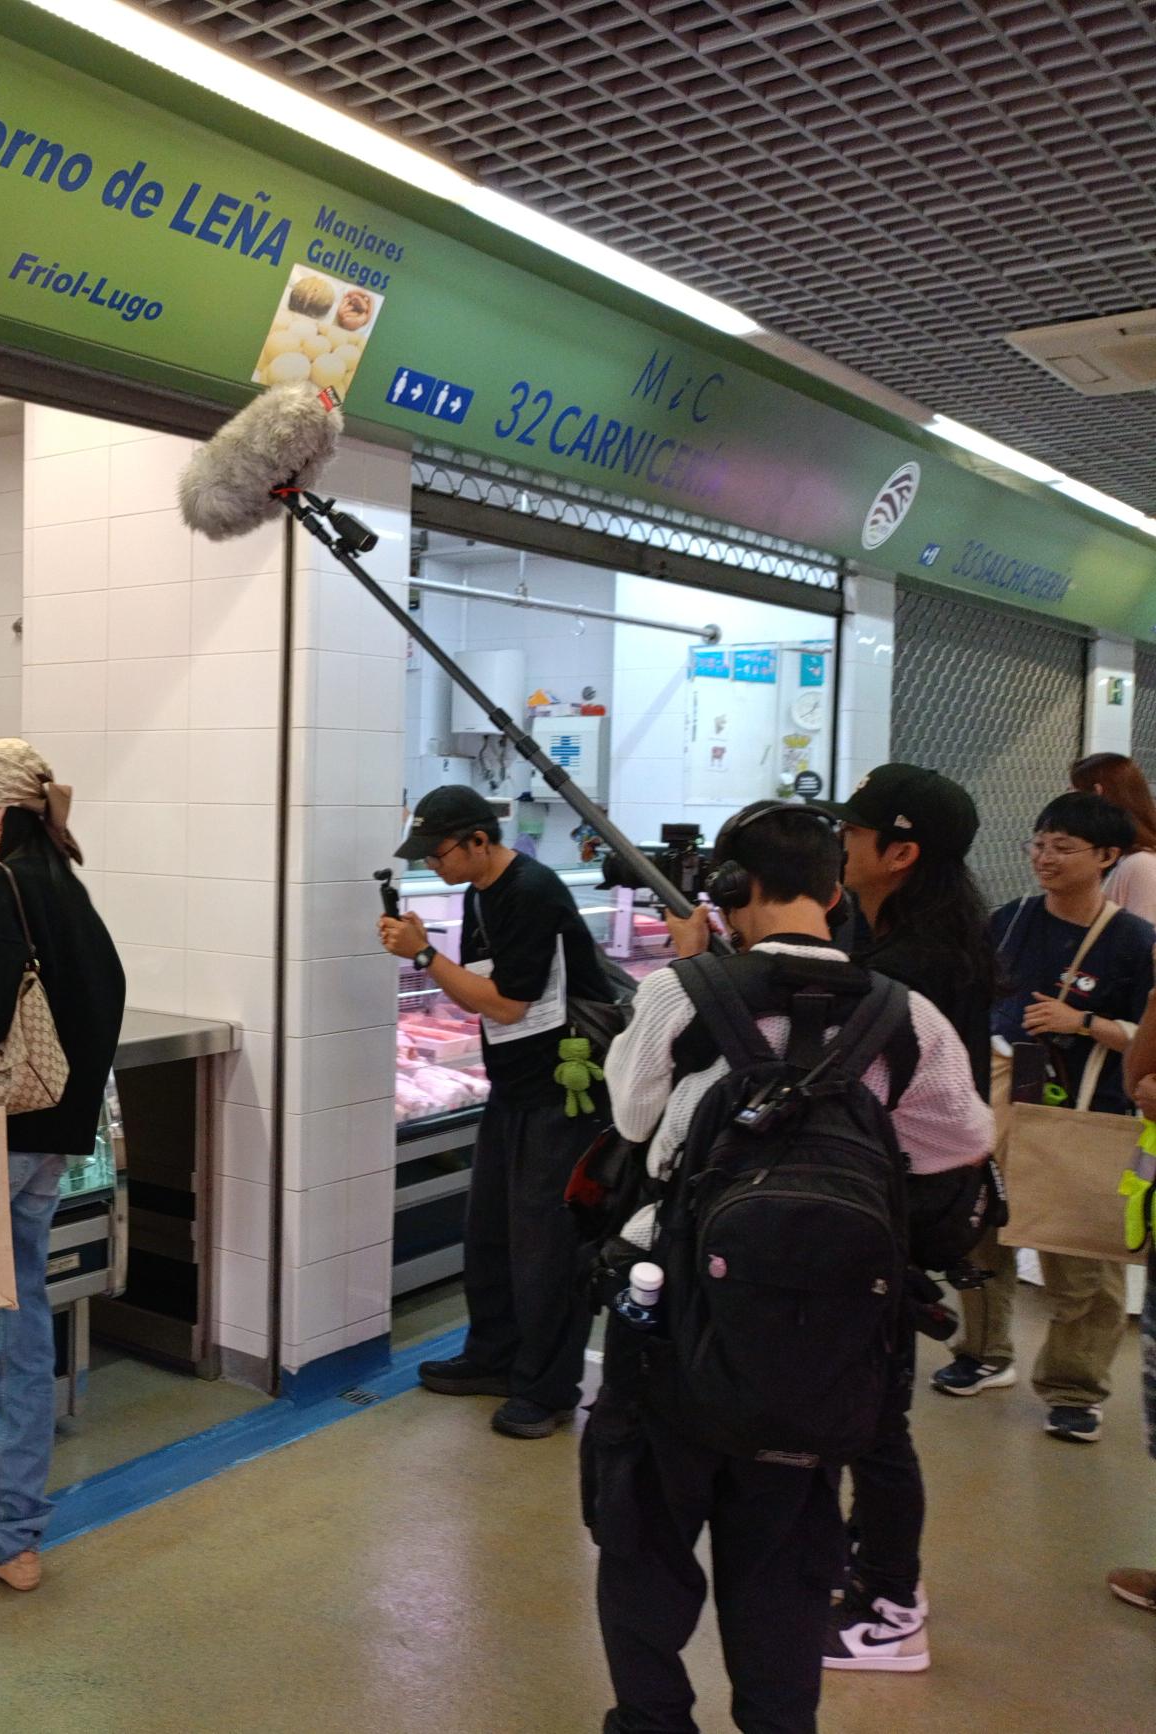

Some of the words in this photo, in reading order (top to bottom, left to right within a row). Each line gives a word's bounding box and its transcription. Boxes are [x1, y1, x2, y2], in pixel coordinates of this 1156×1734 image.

[101, 160, 164, 218] de
[169, 182, 292, 266] LEÑA
[314, 204, 405, 262] Manjares
[8, 252, 163, 322] Friol-Lugo
[307, 238, 391, 290] Gallegos
